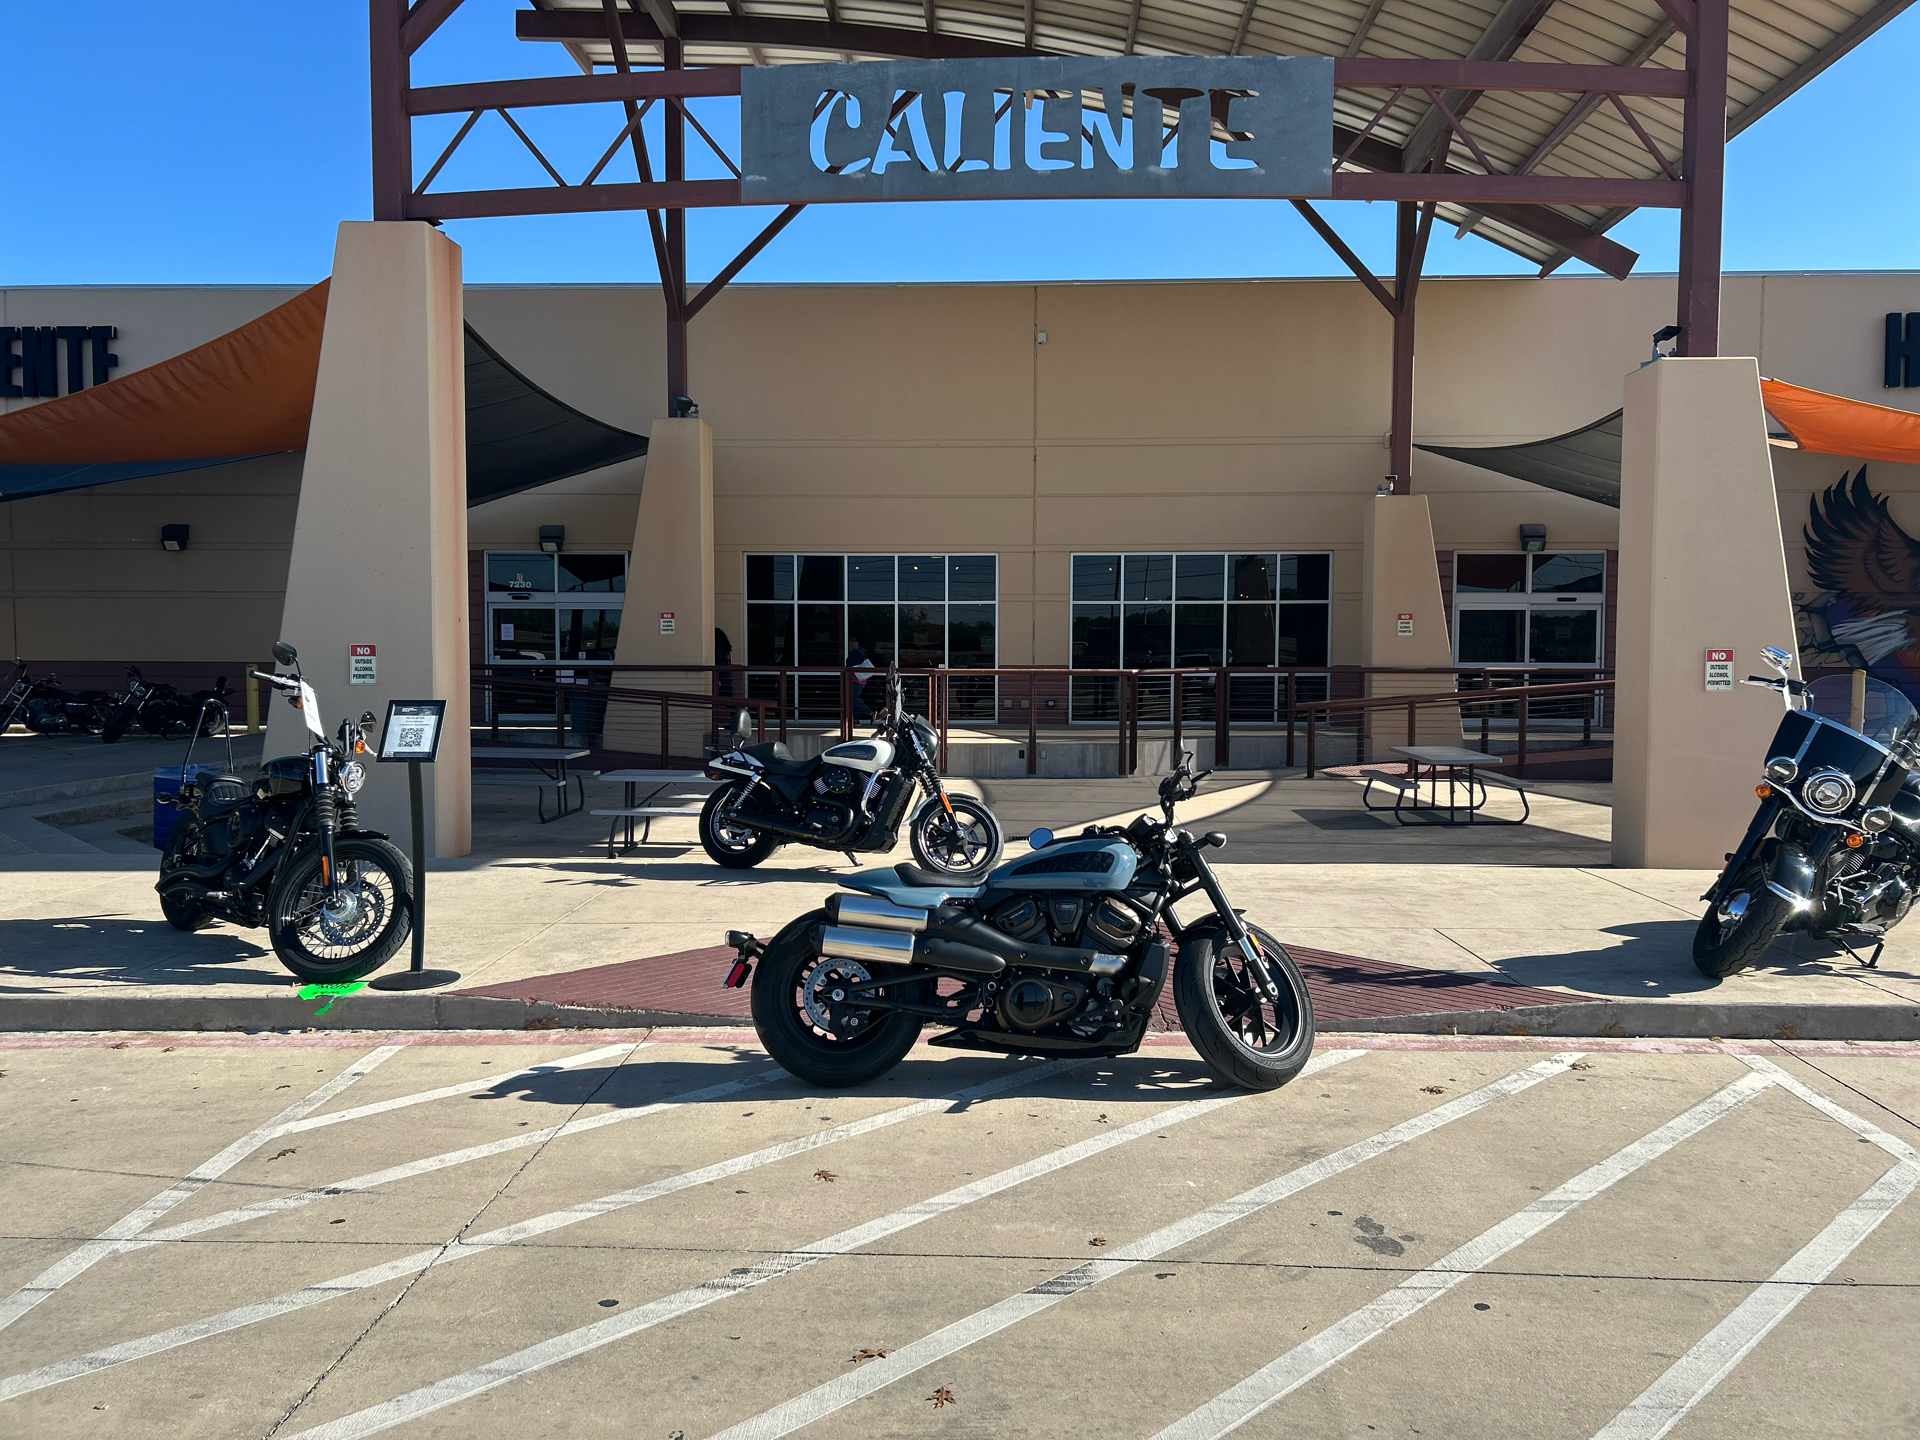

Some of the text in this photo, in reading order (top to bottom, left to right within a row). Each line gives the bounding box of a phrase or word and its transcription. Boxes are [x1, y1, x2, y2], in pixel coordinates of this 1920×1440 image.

[808, 82, 1261, 175] CALIENTE
[508, 581, 532, 589] 7230
[356, 647, 371, 655] NO
[1712, 652, 1726, 660] NO
